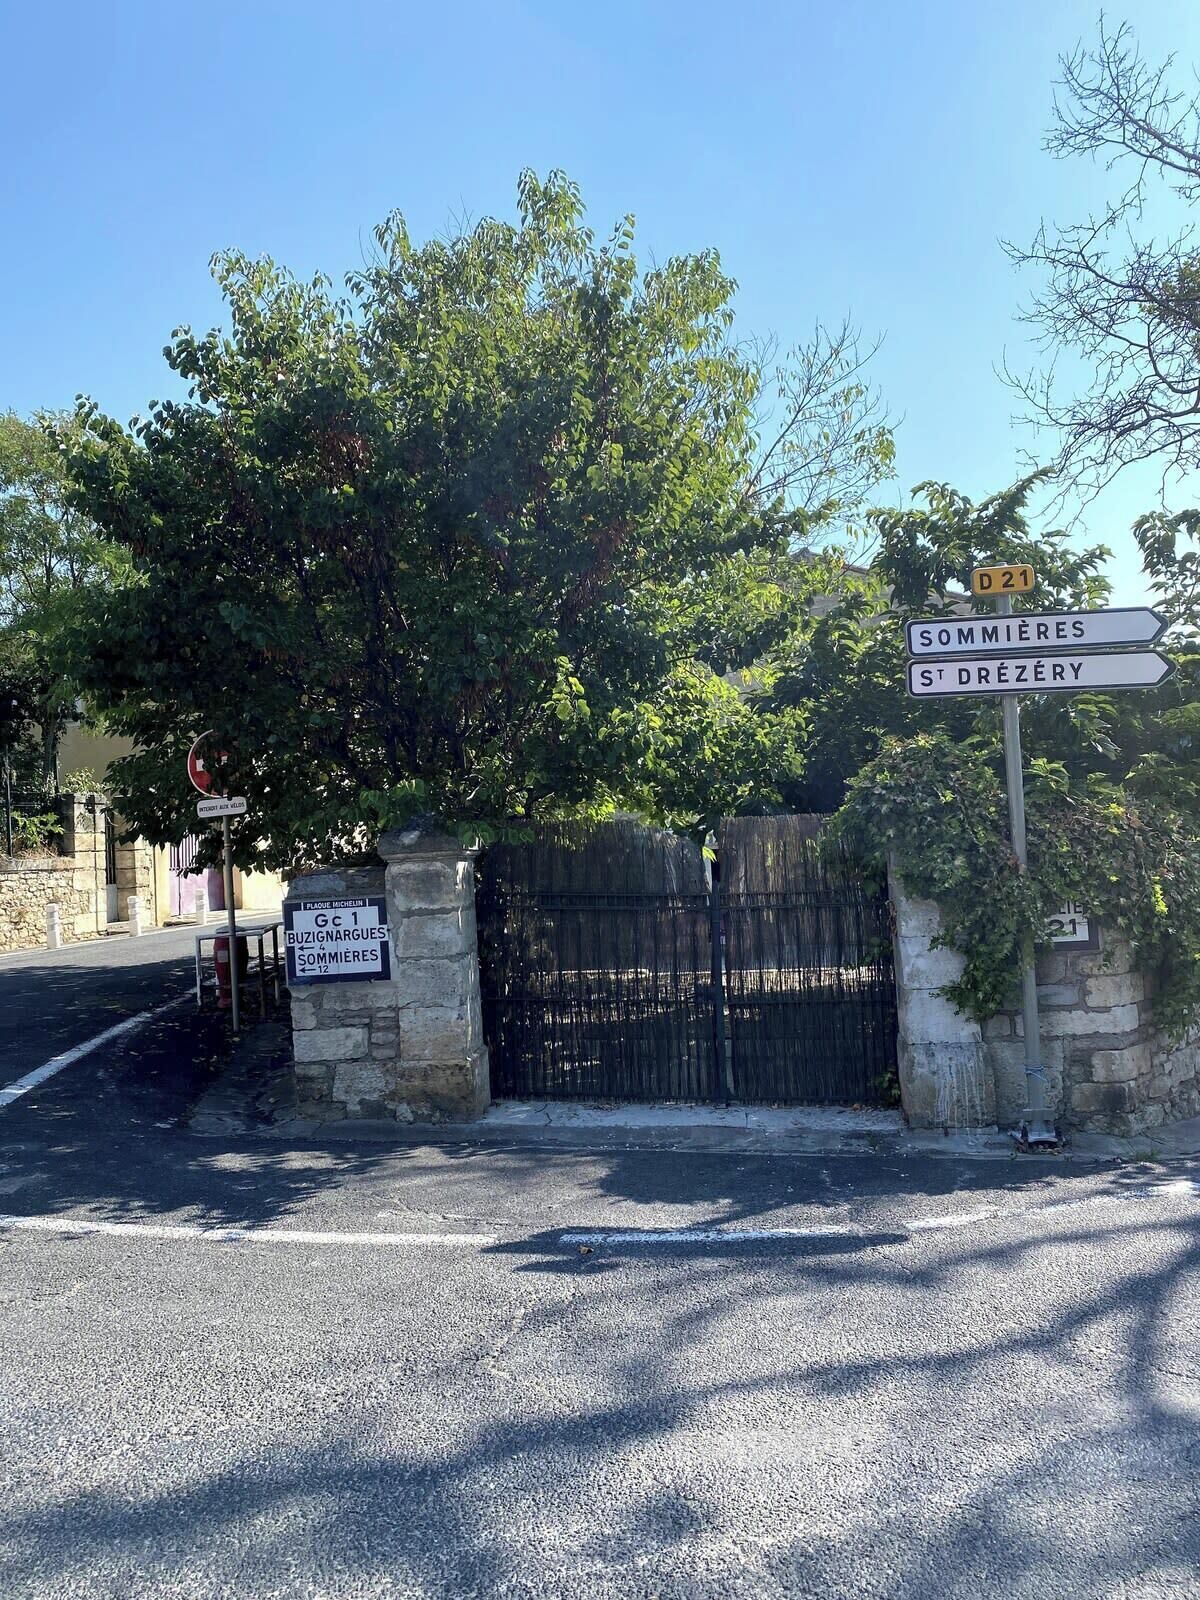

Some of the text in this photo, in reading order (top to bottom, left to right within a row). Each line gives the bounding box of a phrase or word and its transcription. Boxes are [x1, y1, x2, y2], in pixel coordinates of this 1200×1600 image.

[979, 569, 1029, 591] D 21
[919, 620, 1085, 647] SOMMIÈRES
[958, 660, 1083, 685] DRÉZÉRY
[199, 805, 218, 813] INTERDIT
[230, 801, 245, 809] VÉLOS
[306, 899, 363, 910] PLAQUE MICHELIN
[351, 911, 358, 925] 1
[288, 927, 386, 945] BUZIGNARGUES
[319, 943, 326, 951] 4
[298, 947, 379, 966] SOMMIÈRES
[318, 965, 329, 974] 12
